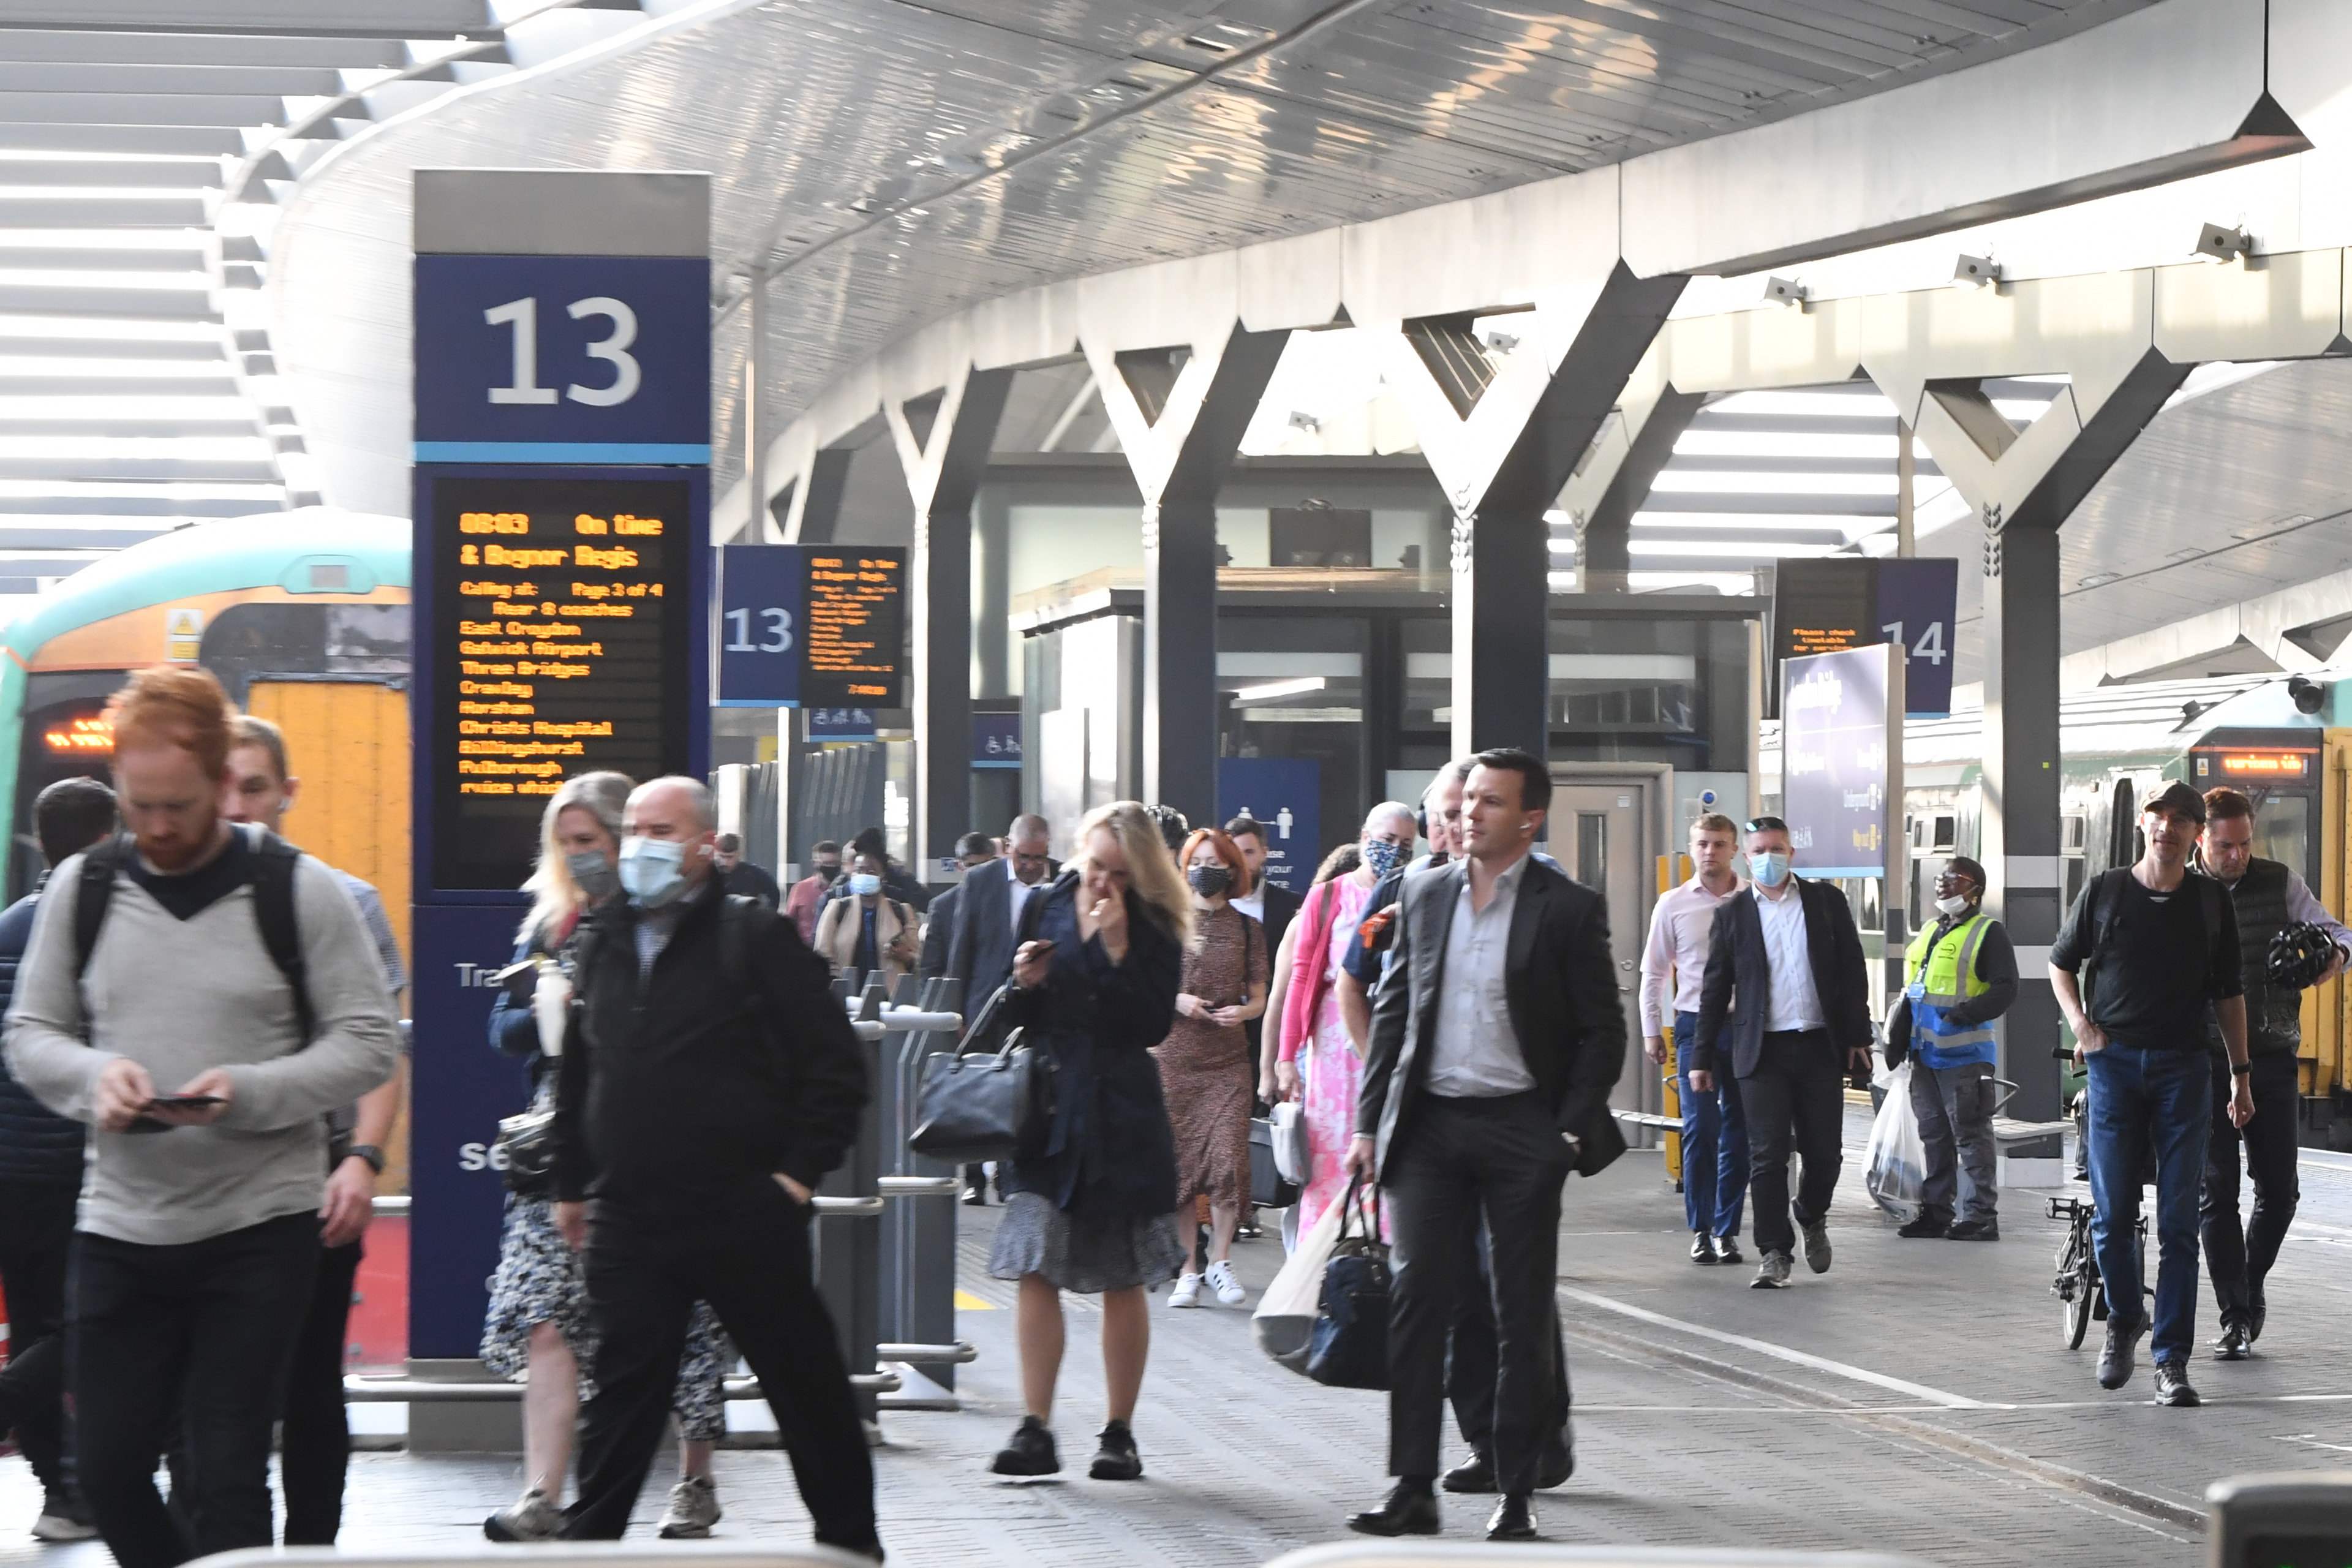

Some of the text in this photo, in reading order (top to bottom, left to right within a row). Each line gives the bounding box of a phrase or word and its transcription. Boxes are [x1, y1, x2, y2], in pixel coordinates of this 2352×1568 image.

[483, 296, 641, 407] 13
[725, 608, 794, 653] 13
[1882, 620, 1947, 665] 14
